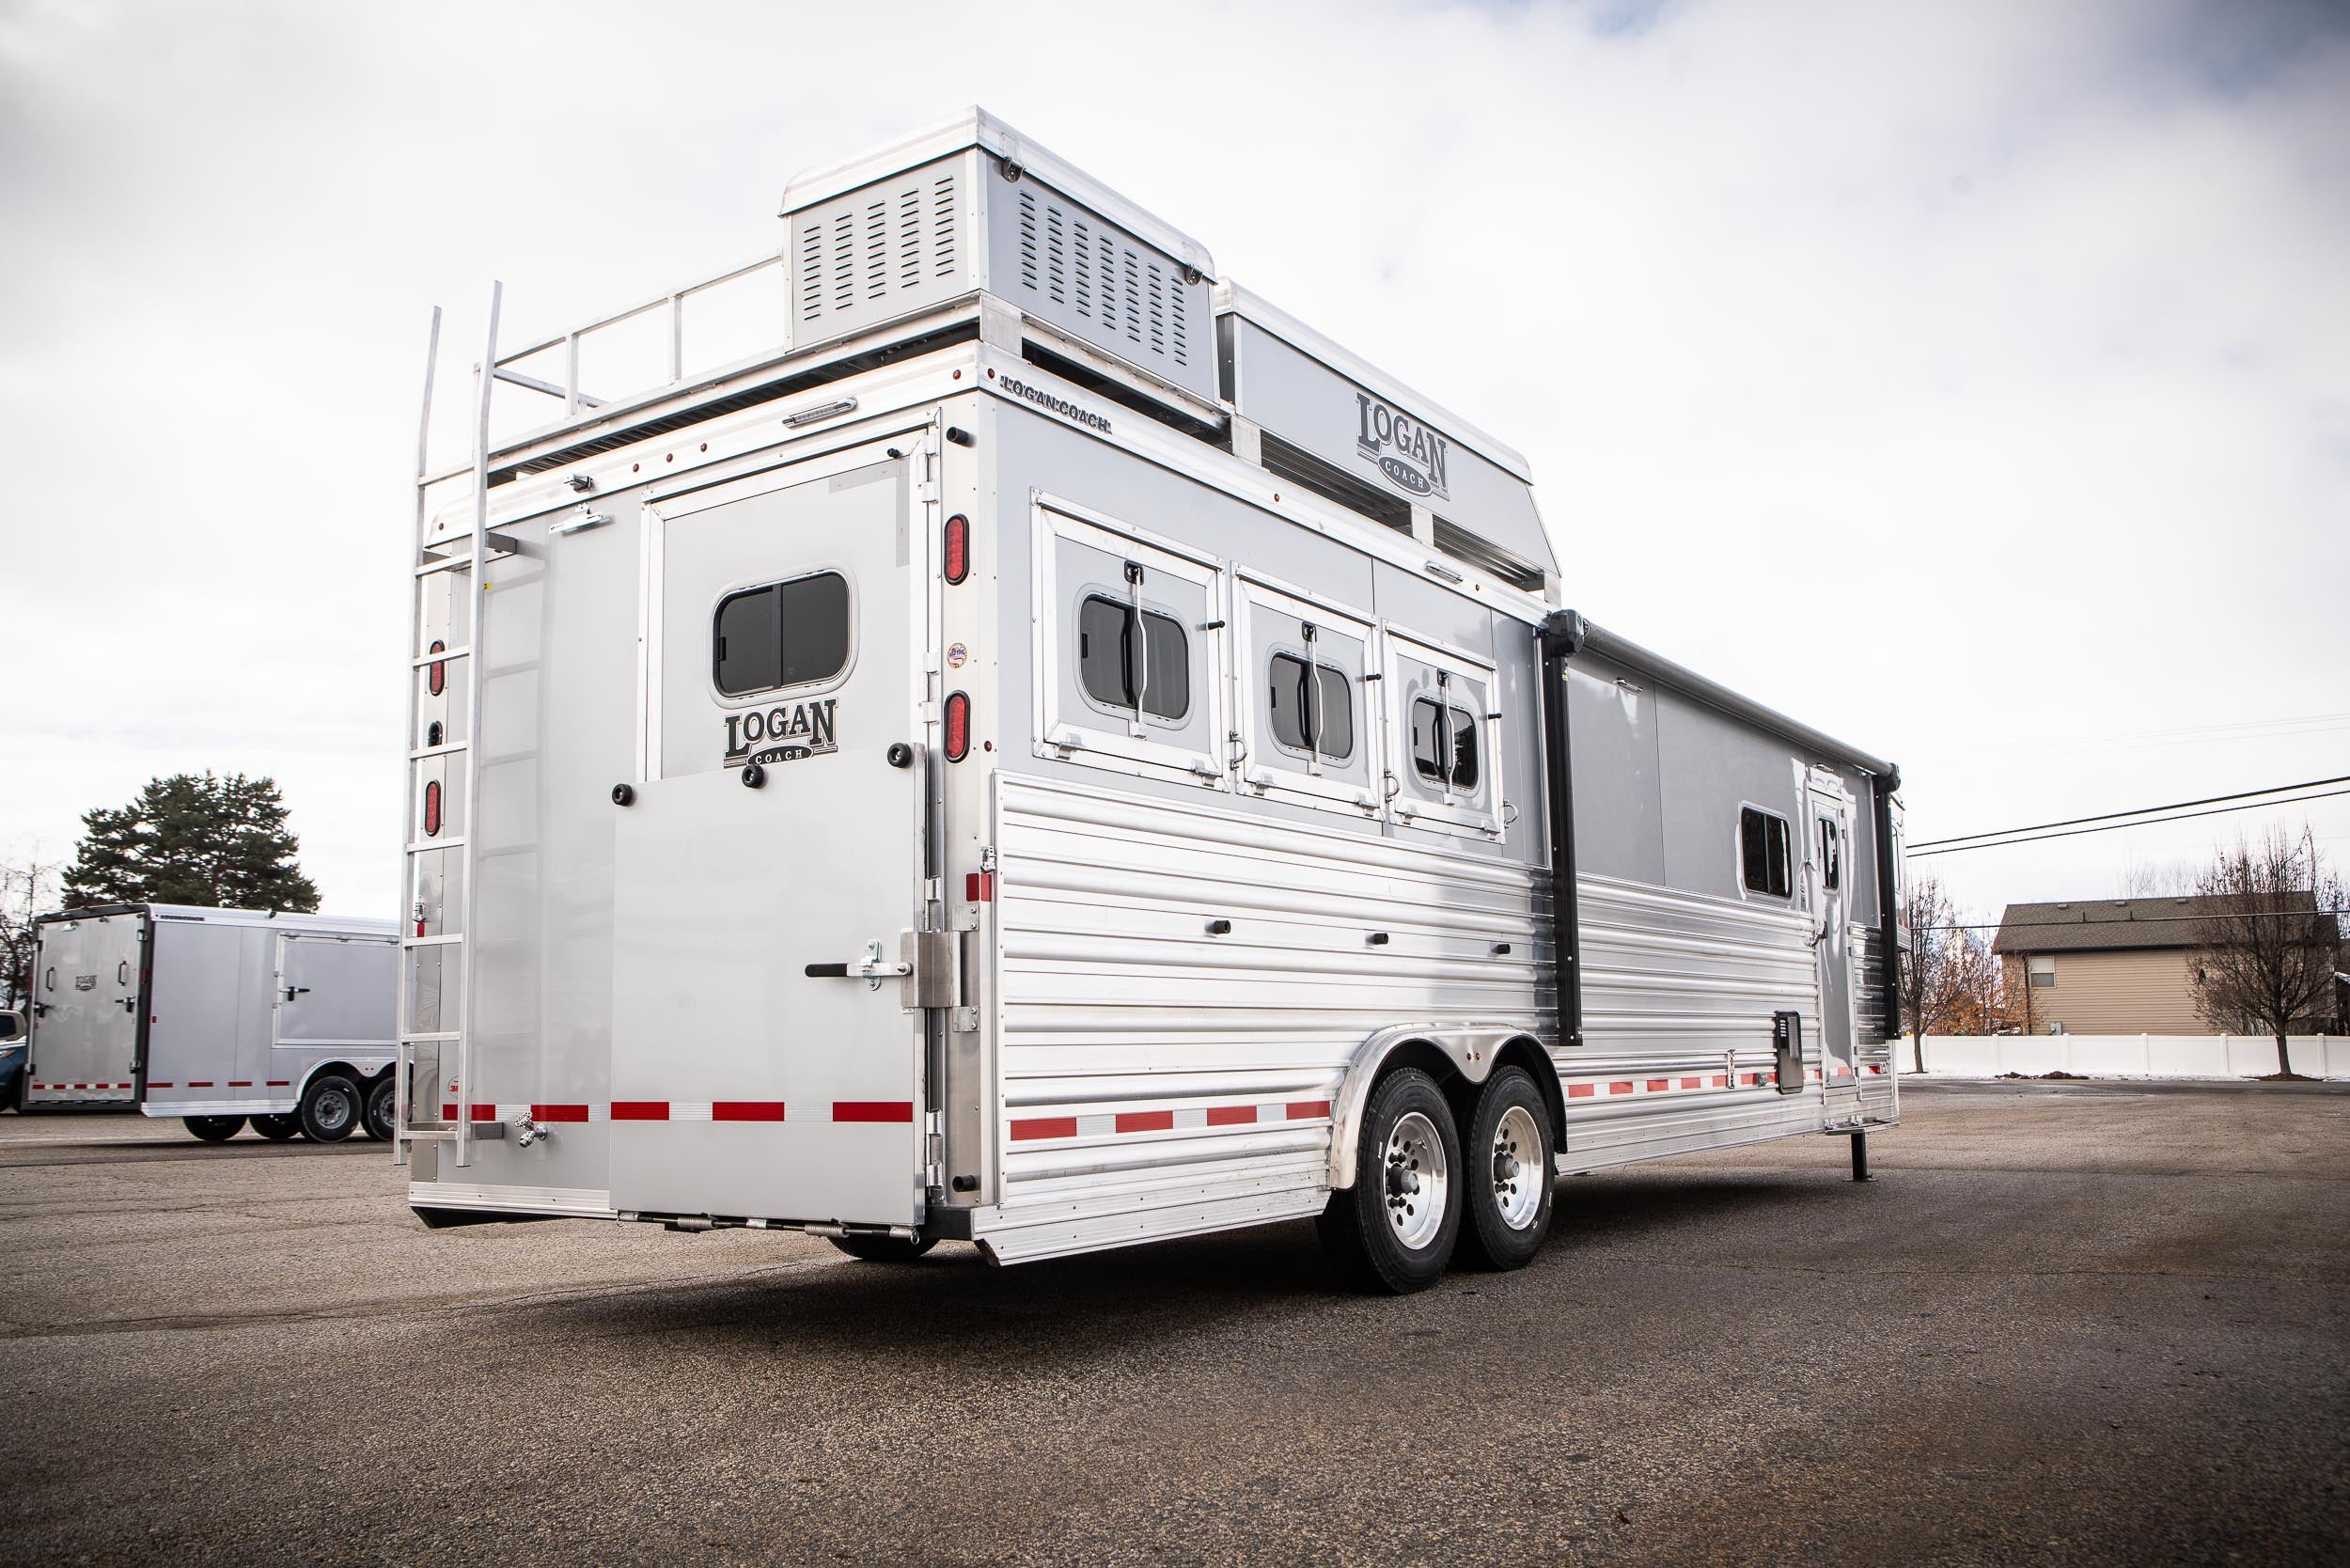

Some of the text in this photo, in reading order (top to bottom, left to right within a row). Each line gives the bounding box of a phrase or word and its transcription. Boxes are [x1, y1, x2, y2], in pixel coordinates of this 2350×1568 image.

[1356, 391, 1448, 491] LOGAN
[1384, 461, 1425, 489] COACH
[725, 698, 837, 758] LOGAN
[754, 748, 804, 764] COACH
